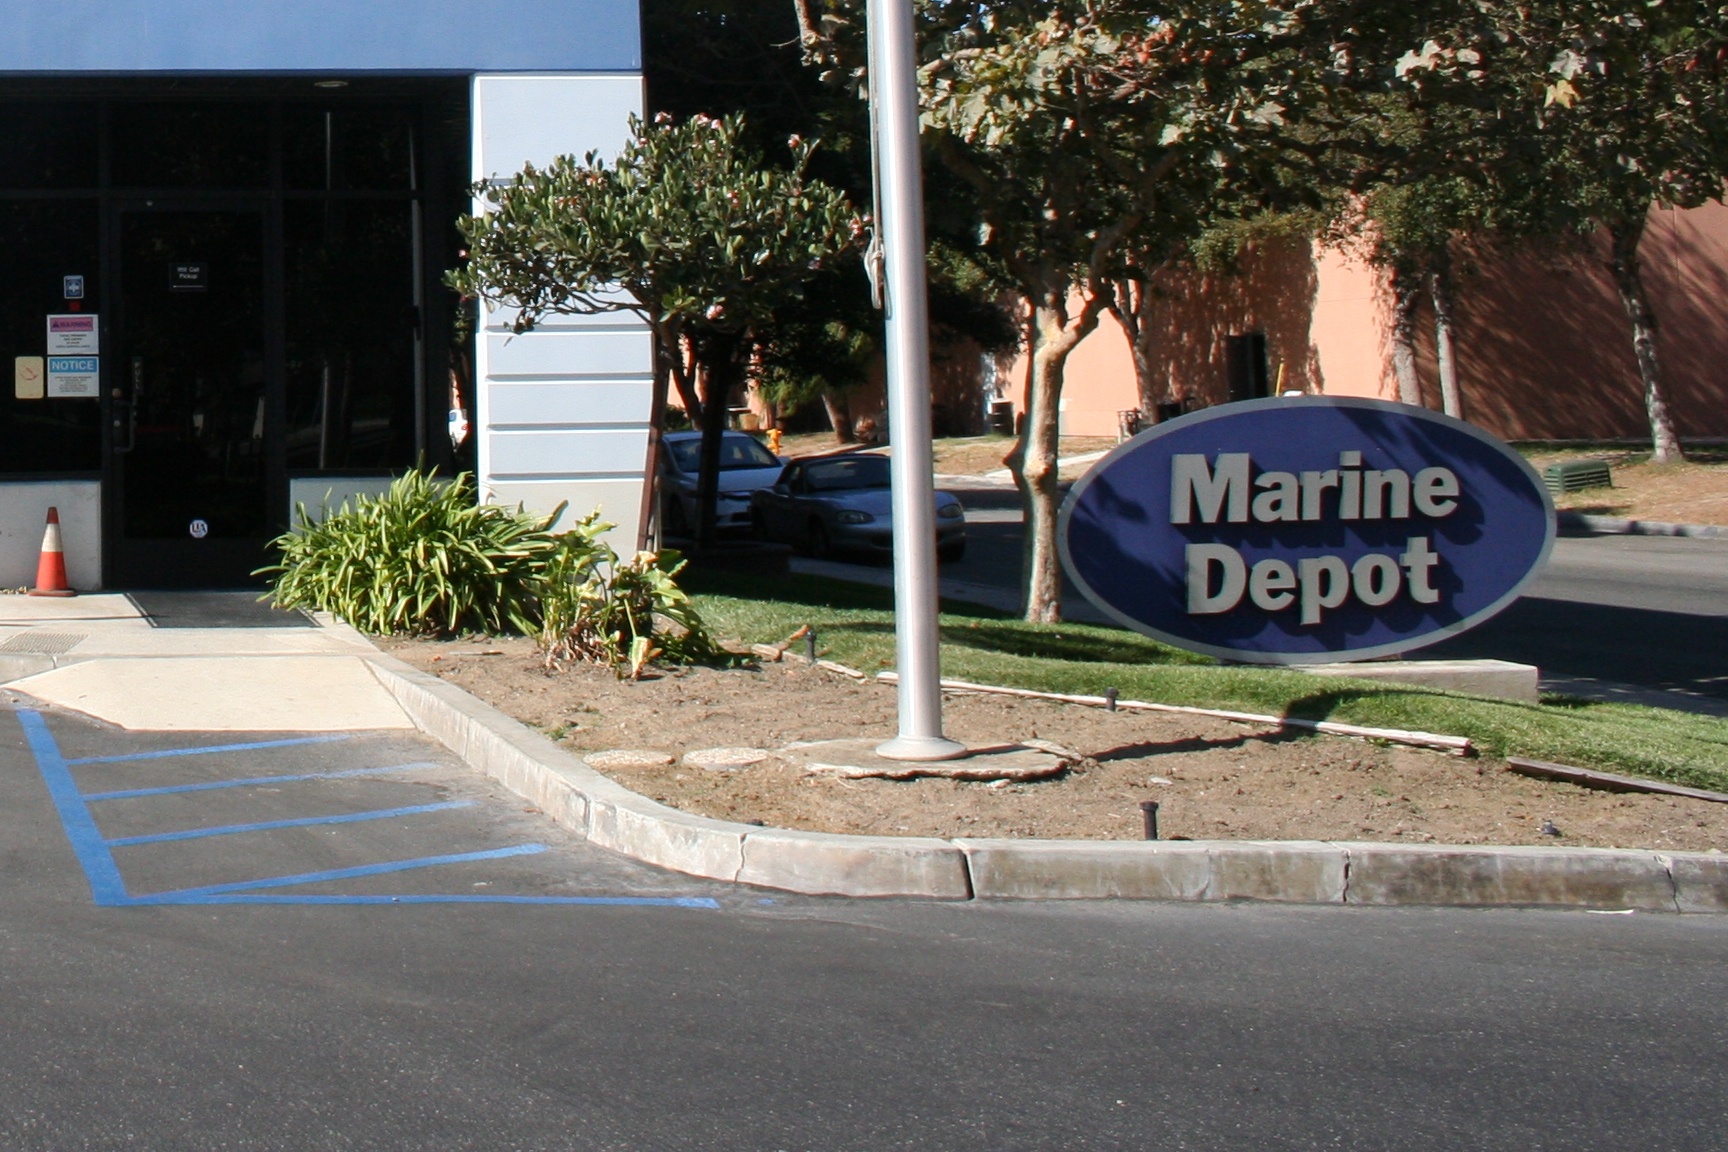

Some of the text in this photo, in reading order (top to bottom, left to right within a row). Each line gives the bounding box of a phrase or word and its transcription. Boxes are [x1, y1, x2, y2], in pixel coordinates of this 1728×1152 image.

[51, 360, 95, 371] NOTICE
[1170, 450, 1460, 525] Marine
[1184, 536, 1439, 626] Depot
